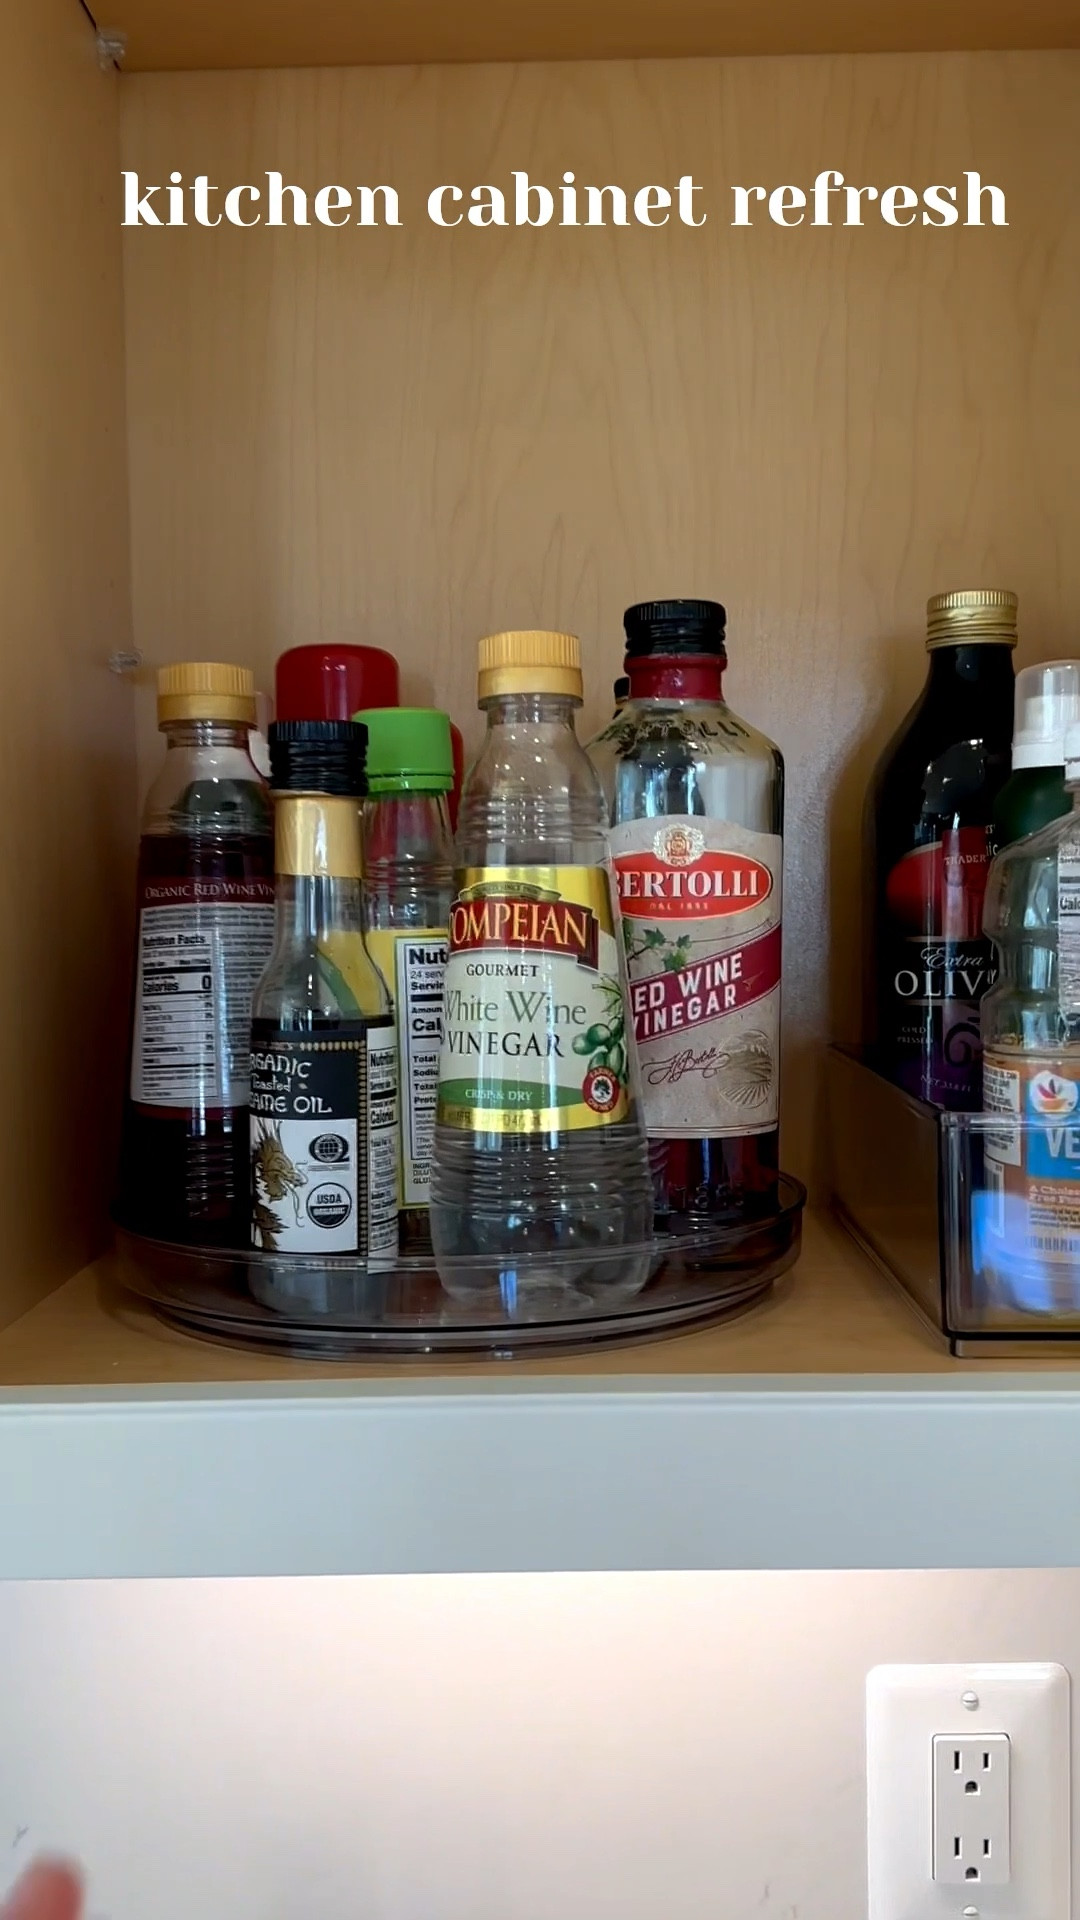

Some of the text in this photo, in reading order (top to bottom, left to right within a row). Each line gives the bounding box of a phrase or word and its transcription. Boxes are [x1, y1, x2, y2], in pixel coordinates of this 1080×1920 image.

[944, 853, 986, 865] TRADER
[145, 885, 191, 899] ORGANIC
[193, 882, 221, 896] RED
[221, 882, 256, 896] WINE
[177, 934, 206, 945] Facts
[920, 946, 984, 969] Extra
[410, 970, 422, 979] 24
[465, 963, 541, 978] GOURMET
[677, 951, 743, 998] WINE
[201, 974, 213, 990] 0
[894, 969, 986, 996] OLIV
[505, 989, 587, 1025] Wine
[412, 1017, 442, 1032] Cal
[447, 1031, 566, 1058] VINEGAR
[412, 1055, 437, 1064] Total
[508, 1090, 534, 1102] DRY
[293, 1096, 333, 1114] OIL
[316, 1193, 342, 1205] USDA
